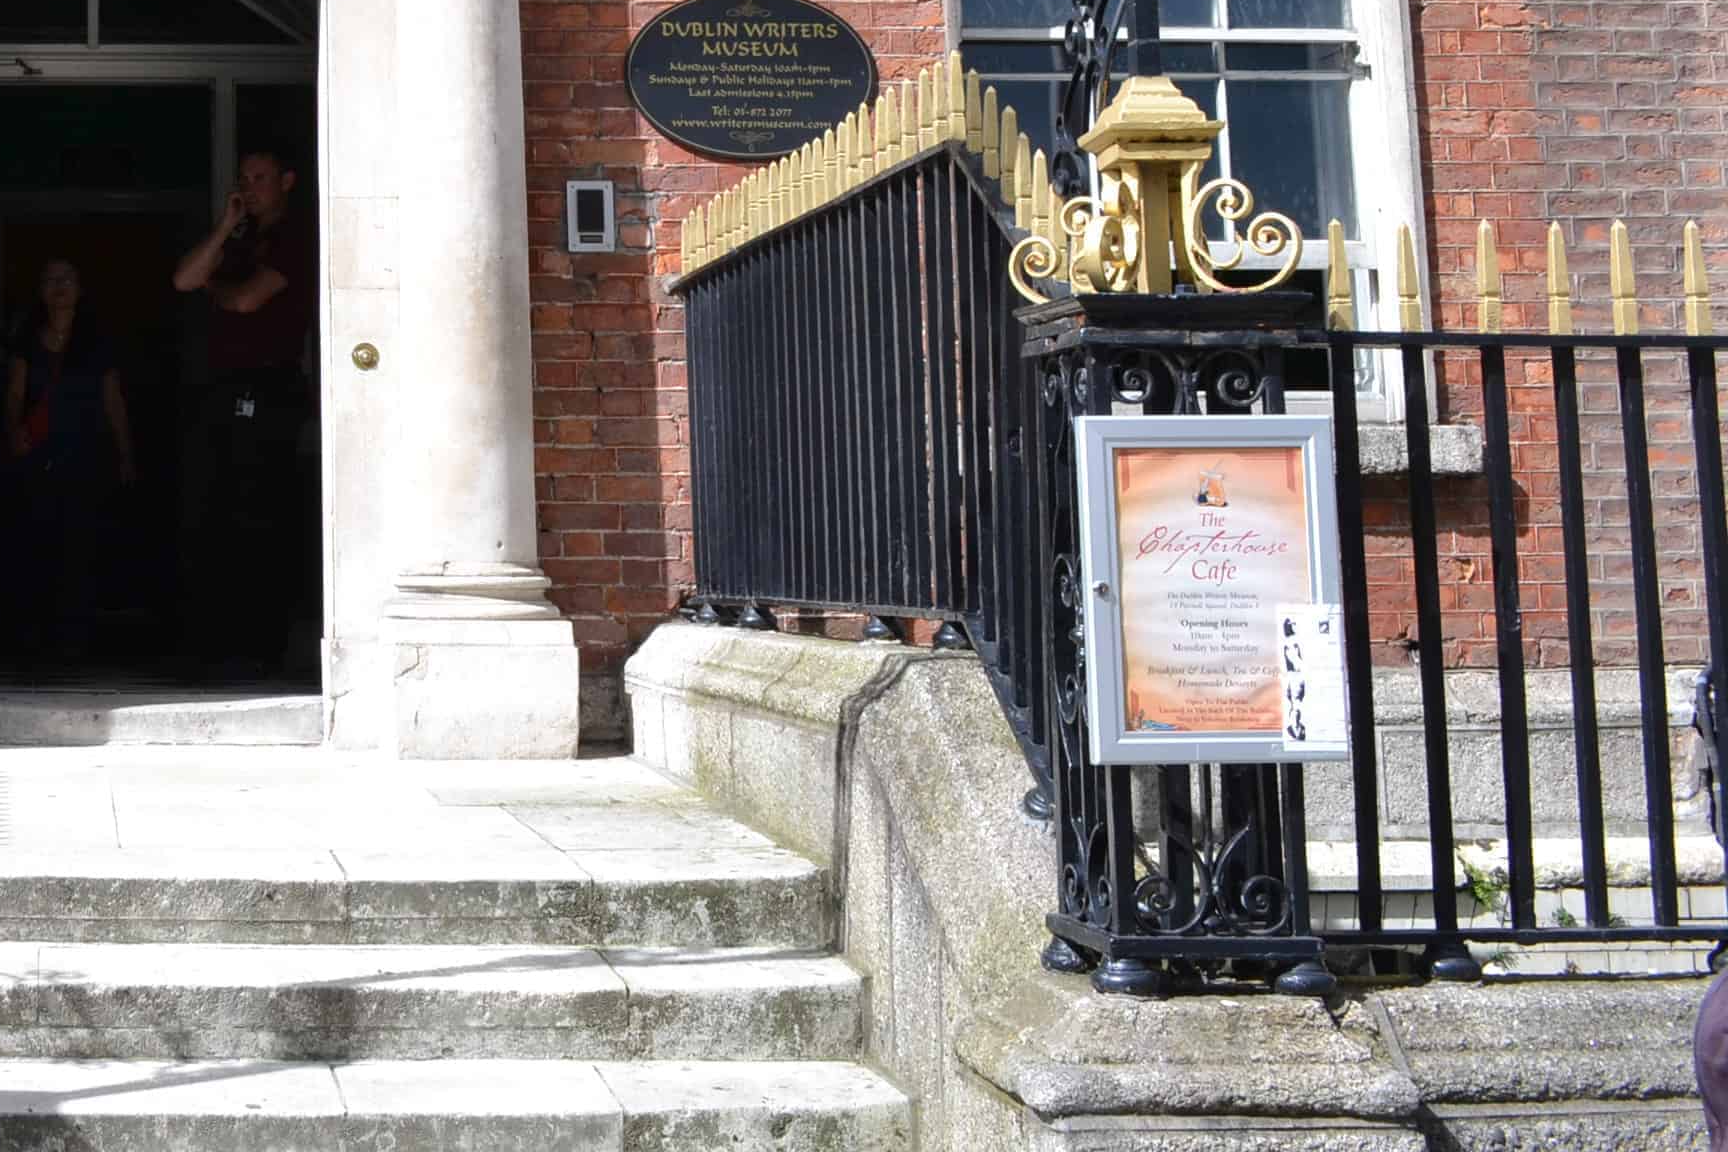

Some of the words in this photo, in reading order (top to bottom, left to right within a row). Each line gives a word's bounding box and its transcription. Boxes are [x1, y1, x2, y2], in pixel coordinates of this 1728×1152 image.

[661, 21, 738, 38] DUBLIN
[743, 22, 839, 39] WRITERS
[702, 41, 800, 57] MUSEUM
[699, 74, 710, 85] &
[1200, 512, 1226, 528] The
[1136, 526, 1289, 575] Chapterhouse
